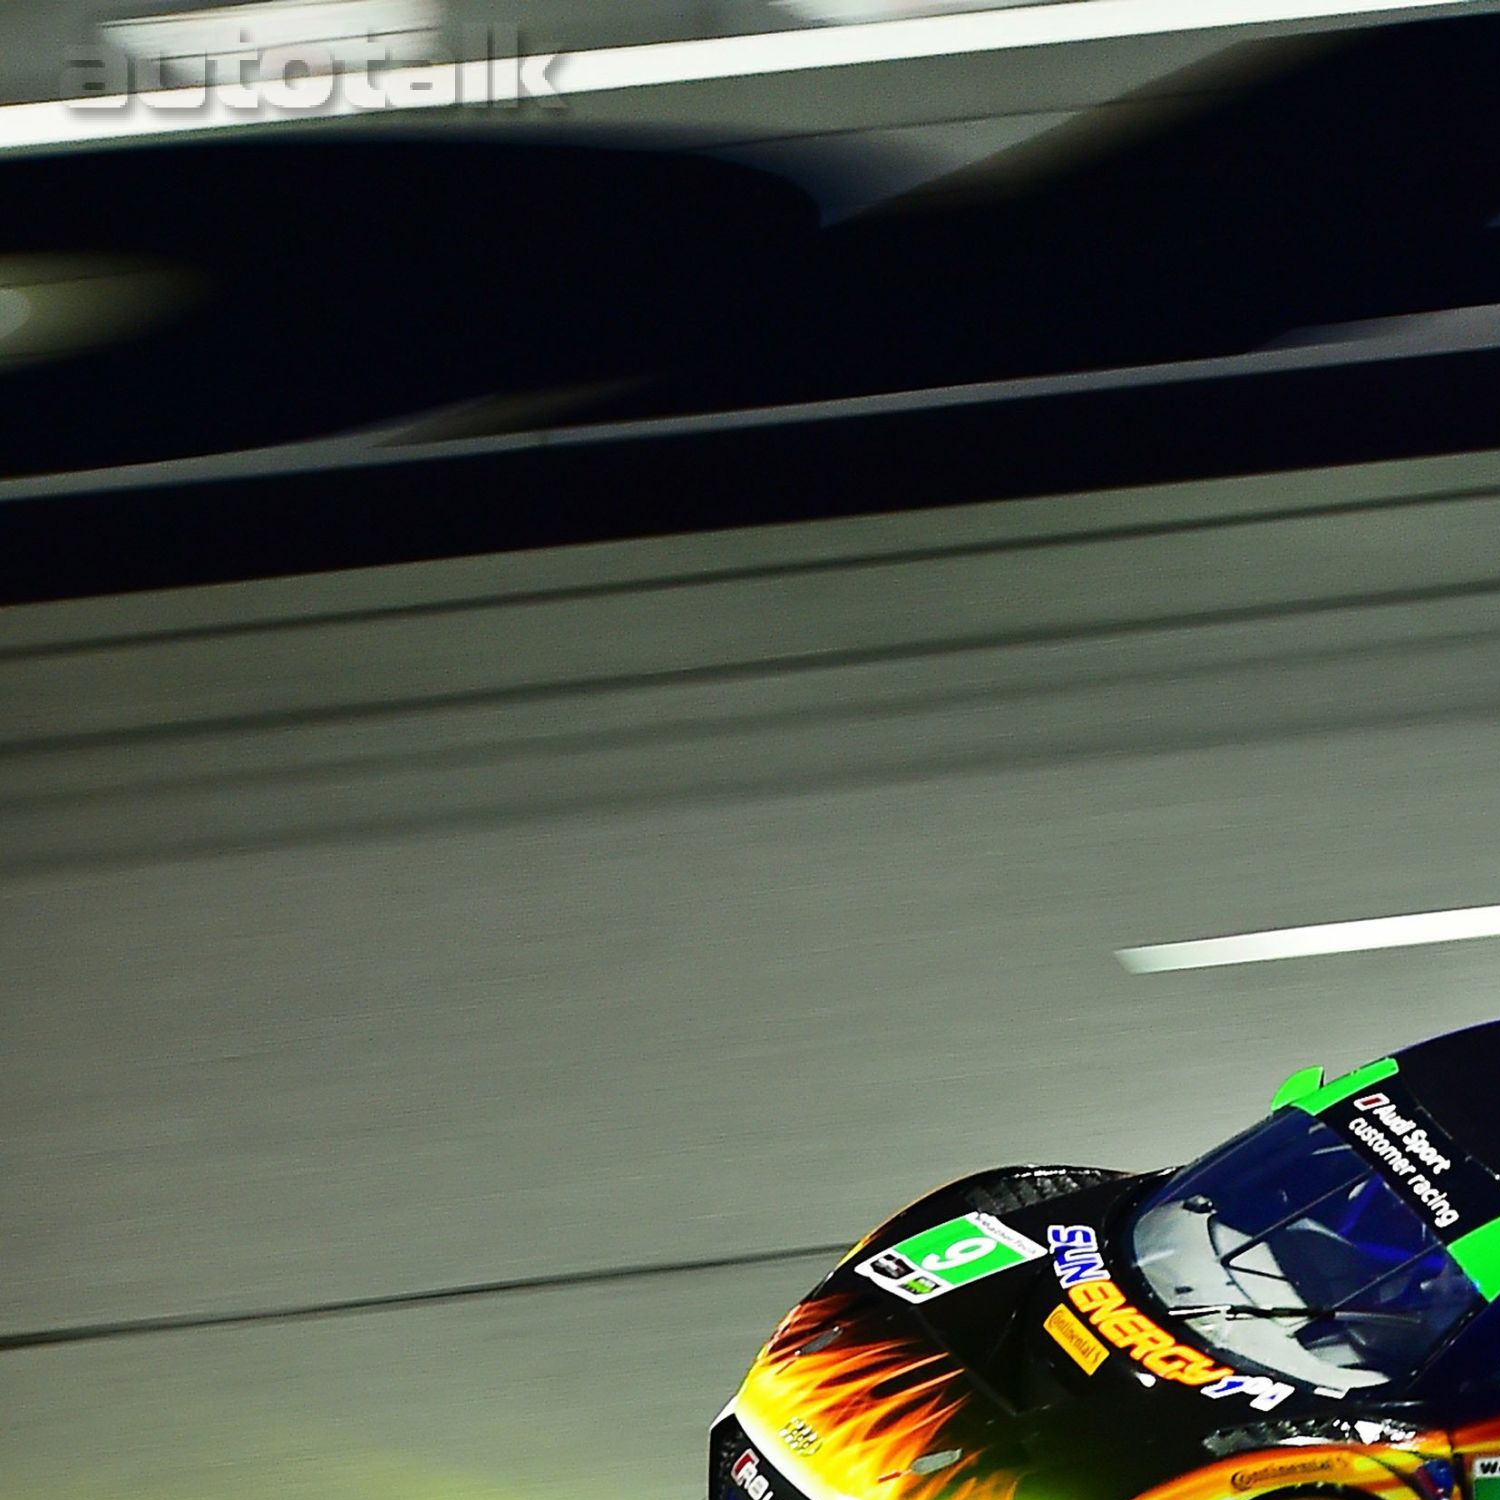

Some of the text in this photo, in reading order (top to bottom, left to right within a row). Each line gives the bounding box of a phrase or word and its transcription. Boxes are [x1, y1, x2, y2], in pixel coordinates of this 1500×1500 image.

[1349, 1117, 1459, 1228] customer racing
[1373, 1104, 1450, 1174] Audi Sport
[921, 1237, 998, 1271] 9
